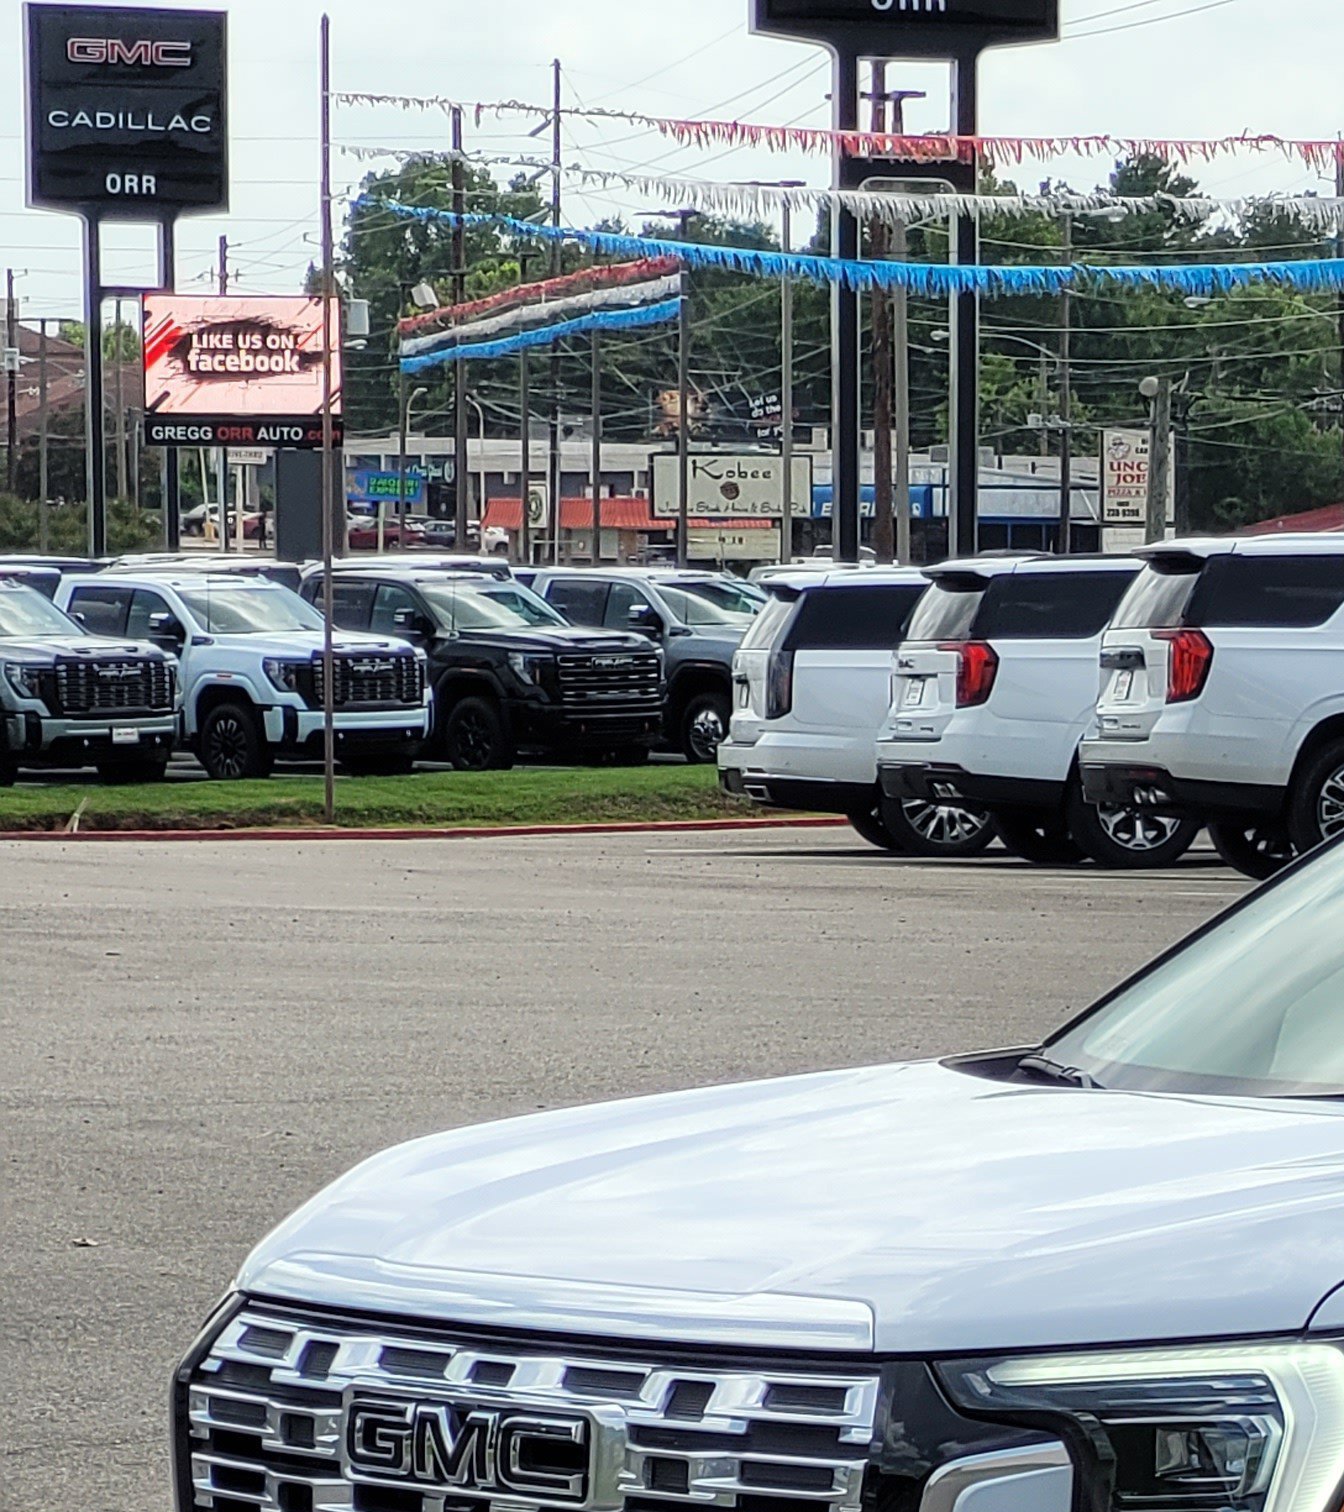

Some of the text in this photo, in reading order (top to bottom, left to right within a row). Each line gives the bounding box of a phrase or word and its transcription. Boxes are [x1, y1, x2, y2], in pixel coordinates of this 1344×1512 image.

[66, 36, 192, 67] GMC
[48, 110, 212, 133] CADILLAC
[105, 173, 157, 195] ORR
[191, 334, 295, 350] LIKE US ON
[187, 348, 301, 372] facebook
[151, 426, 213, 441] GREGG
[216, 426, 254, 441] ORR
[691, 458, 772, 480] Kobee
[347, 1397, 586, 1497] GMC
